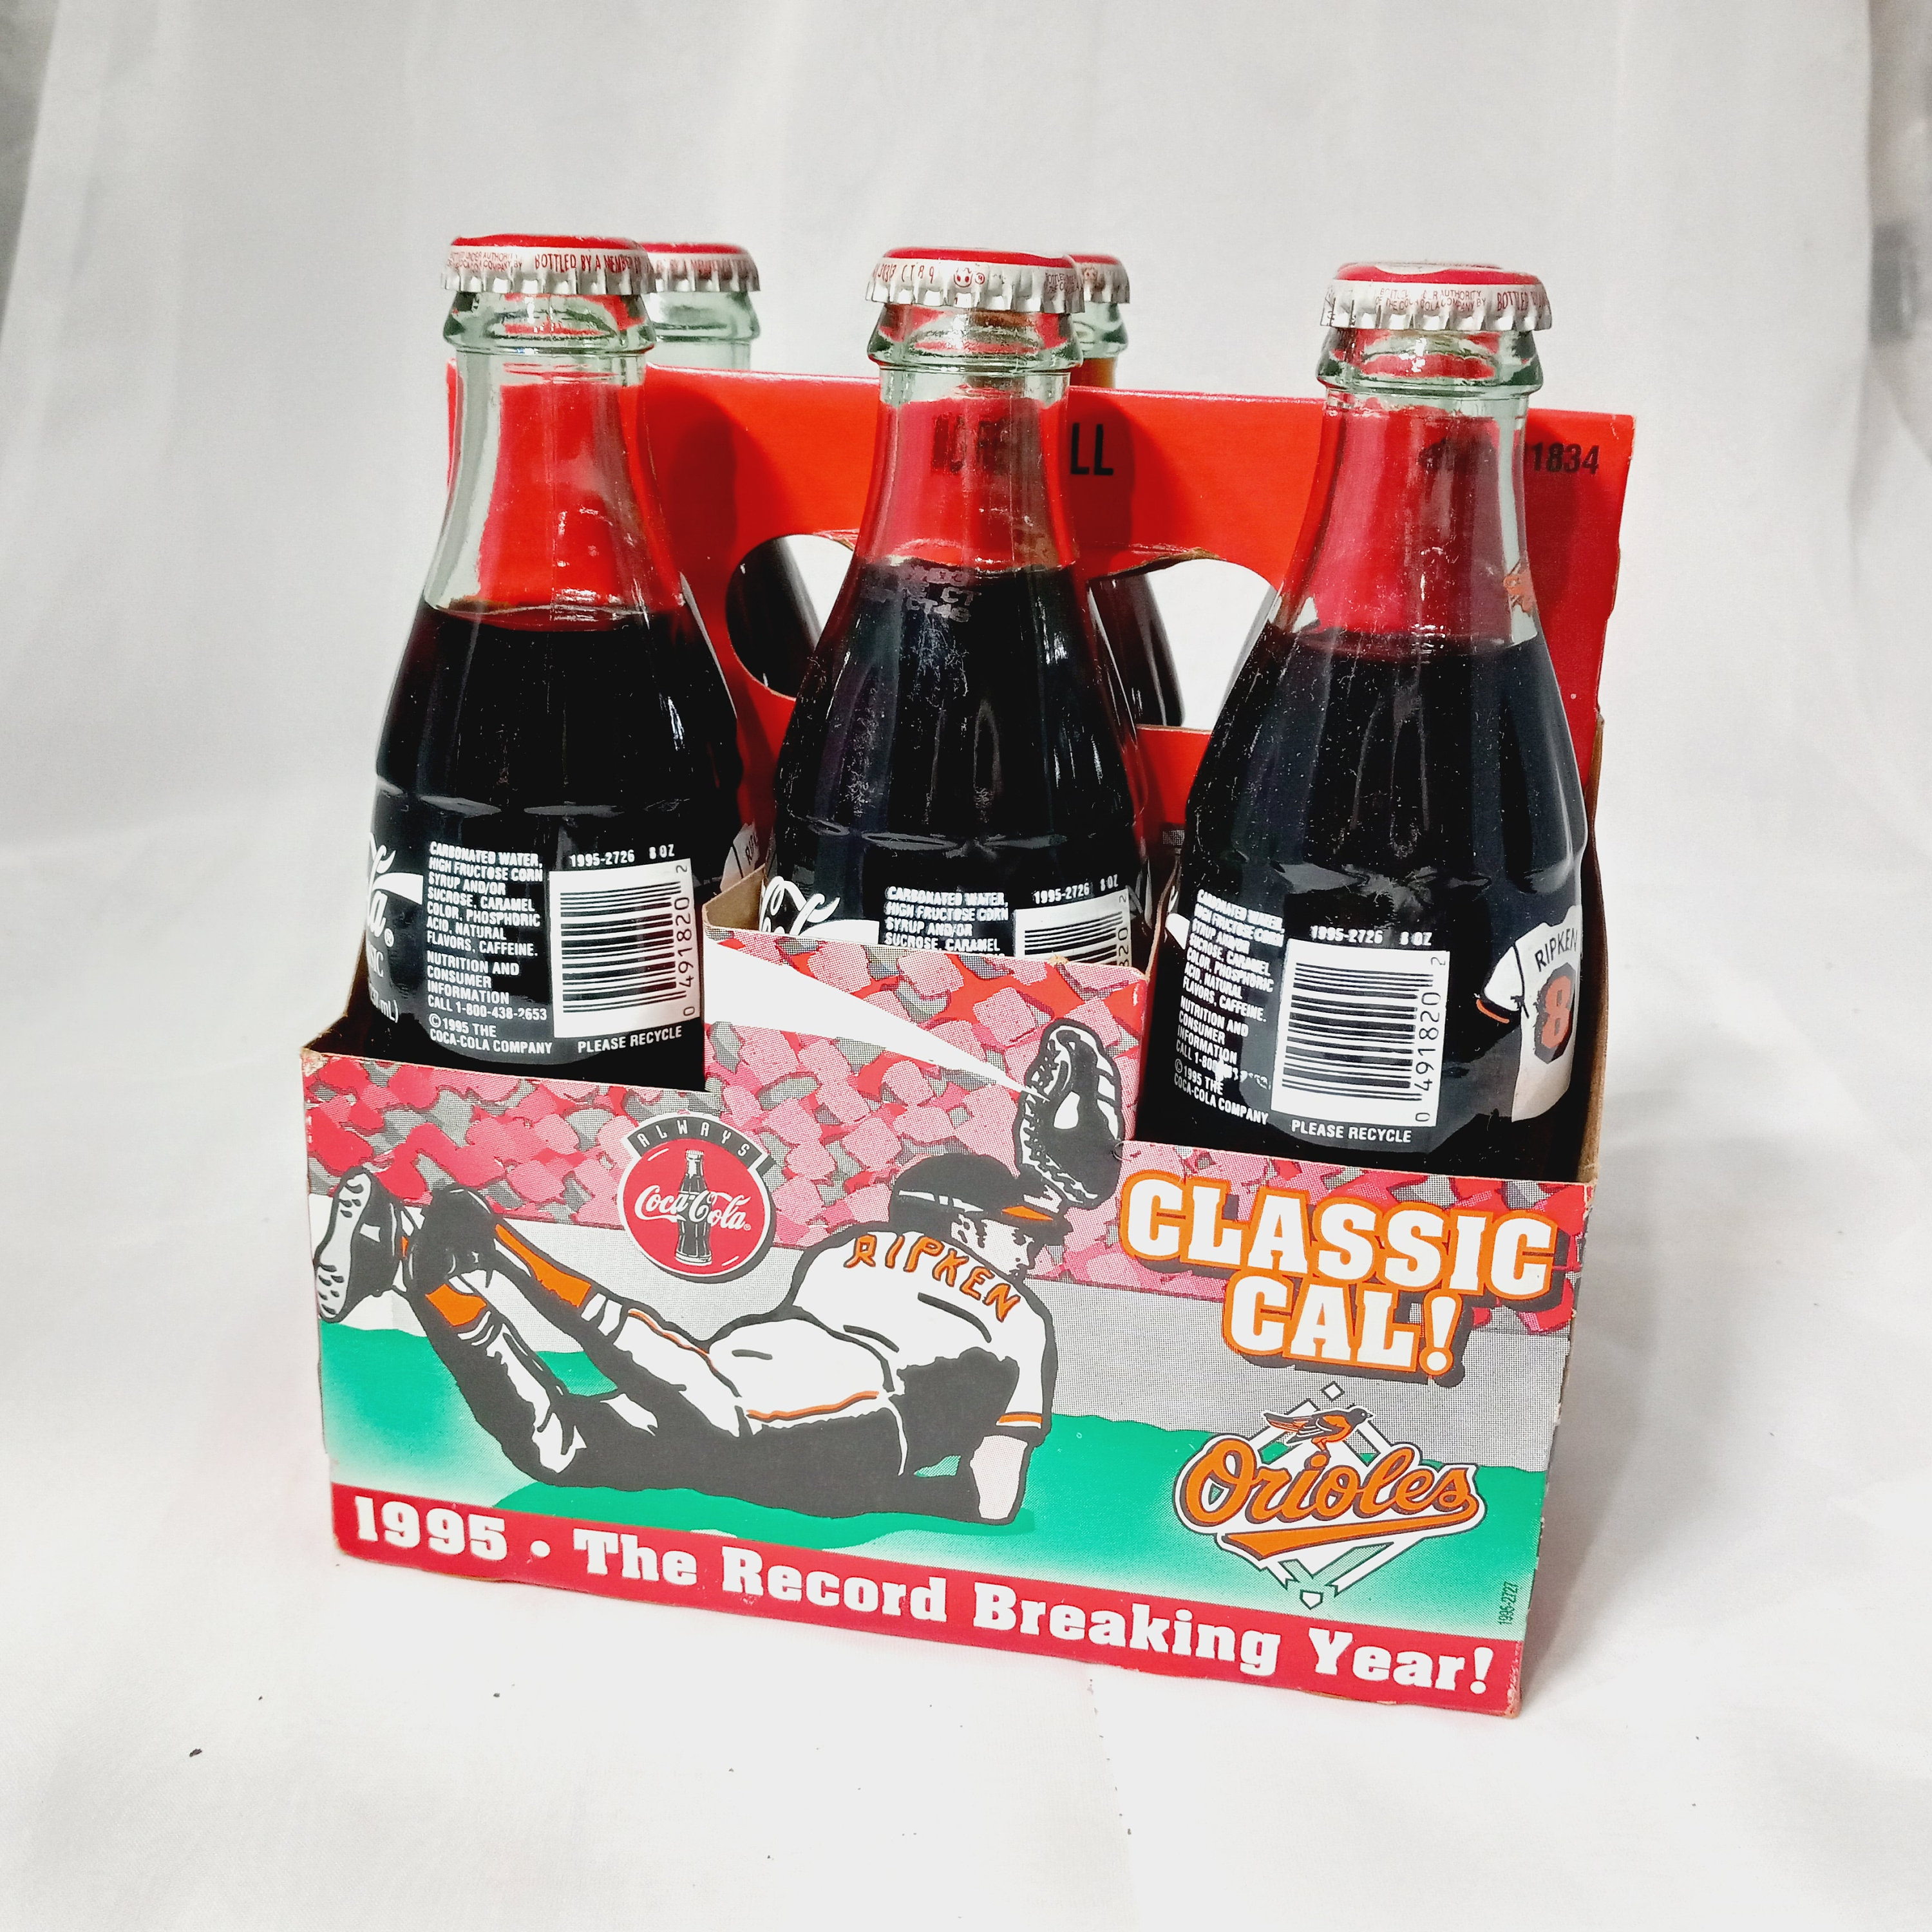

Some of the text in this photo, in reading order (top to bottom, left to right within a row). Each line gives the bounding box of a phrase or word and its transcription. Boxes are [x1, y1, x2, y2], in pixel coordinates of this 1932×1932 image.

[535, 254, 576, 273] BOTTLED
[581, 254, 592, 273] BY
[595, 254, 601, 272] A
[430, 841, 543, 868] CARBONATED WATER,
[569, 849, 635, 867] 1995-2726
[659, 844, 675, 858] OZ
[428, 857, 543, 882] HIGH FRUCTOSE CORN
[428, 871, 506, 895] SYRUP AND/OR
[885, 886, 963, 906] CARBONATED
[1033, 882, 1090, 904] 1995-2726
[1106, 874, 1119, 889] OZ
[480, 896, 535, 911] CARAMEL
[884, 902, 1009, 921] HIGH FRUCTOSE CORN
[455, 922, 507, 940] NATURAL
[466, 909, 541, 927] PHOSPHORIC
[885, 916, 973, 938] SYRUP AND/OR
[1192, 918, 1217, 940] SYRUP
[427, 931, 538, 956] FLAVORS, CAFFEINE.
[674, 896, 694, 988] 491820
[945, 938, 1000, 952] CARAMEL
[1310, 925, 1384, 944] 1995-2726
[1411, 931, 1433, 946] OZ
[427, 950, 520, 976] NUTRITION AND
[1534, 927, 1578, 972] RIPKEN
[427, 965, 492, 989] CONSUMER
[1214, 961, 1274, 993] PHOSPHORIC
[1226, 950, 1271, 977] CARAMEL
[427, 980, 509, 1004] INFORMATION
[1204, 972, 1243, 999] NATURAL
[428, 994, 547, 1021] CALL 1-800-438-2653
[1180, 995, 1249, 1037] NUTRITION AND
[1218, 994, 1267, 1023] CAFFEINE.
[1538, 968, 1574, 1057] 8
[430, 1028, 553, 1054] COCA-COLA COMPANY
[472, 1023, 497, 1037] THE
[578, 1025, 683, 1053] PLEASE RECYCLE
[1179, 1010, 1226, 1045] CONSUMER
[1176, 1039, 1193, 1060] CALL
[1177, 1025, 1238, 1065] INFORMATION
[1414, 992, 1442, 1092] 491820
[1174, 1073, 1269, 1125] COCA-COLA COMPANY
[1204, 1076, 1224, 1095] THE
[636, 1119, 751, 1158] ALWAYS
[1291, 1119, 1412, 1143] PLEASE RECYCLE
[634, 1185, 752, 1231] Coca-Cola
[1122, 1172, 1556, 1297] CLASSIC
[843, 1233, 1022, 1323] RIPKEN
[1226, 1273, 1460, 1373] CAL!
[1179, 1436, 1484, 1539] Orioles
[354, 1495, 1496, 1695] 1995 The Record Breaking Year!
